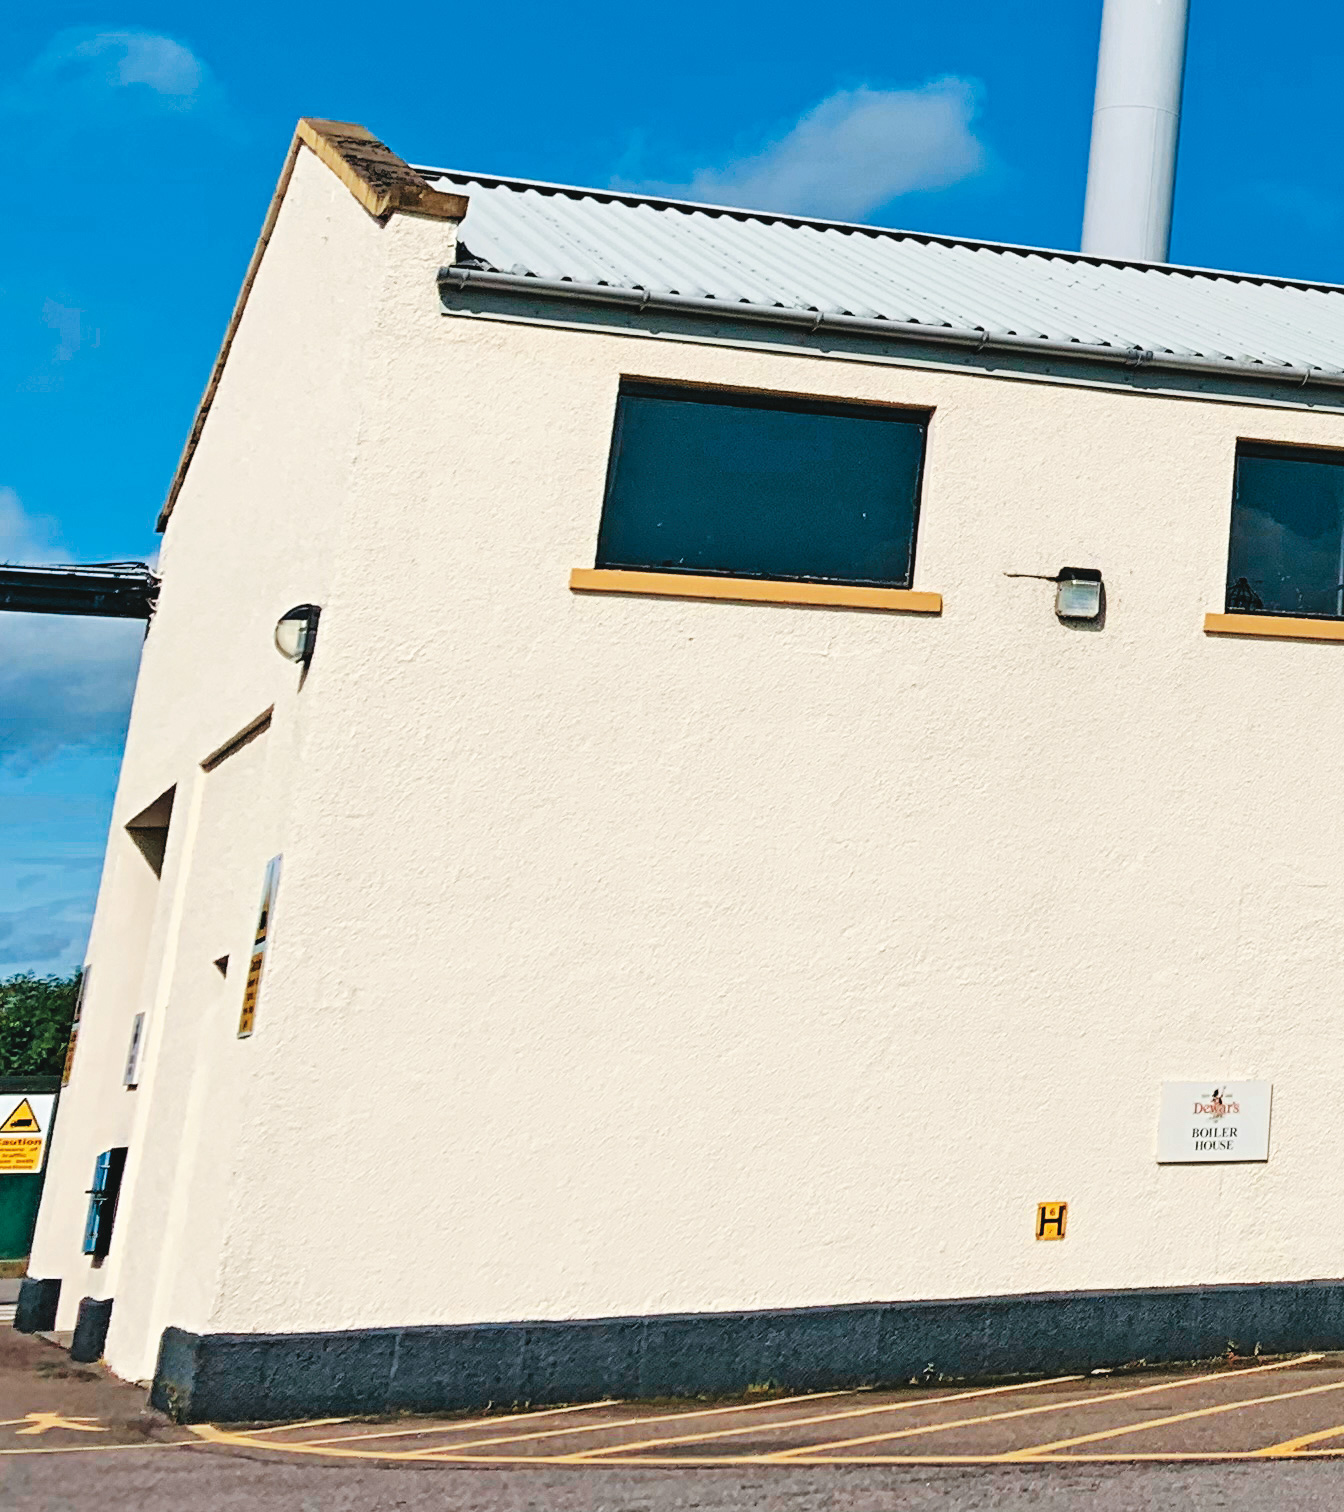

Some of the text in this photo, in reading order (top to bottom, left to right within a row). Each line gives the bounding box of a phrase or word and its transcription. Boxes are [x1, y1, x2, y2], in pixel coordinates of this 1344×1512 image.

[1193, 1102, 1240, 1115] Dewar's
[1192, 1127, 1238, 1138] BOILER
[1195, 1140, 1234, 1151] HOUSE
[1039, 1206, 1065, 1236] H
